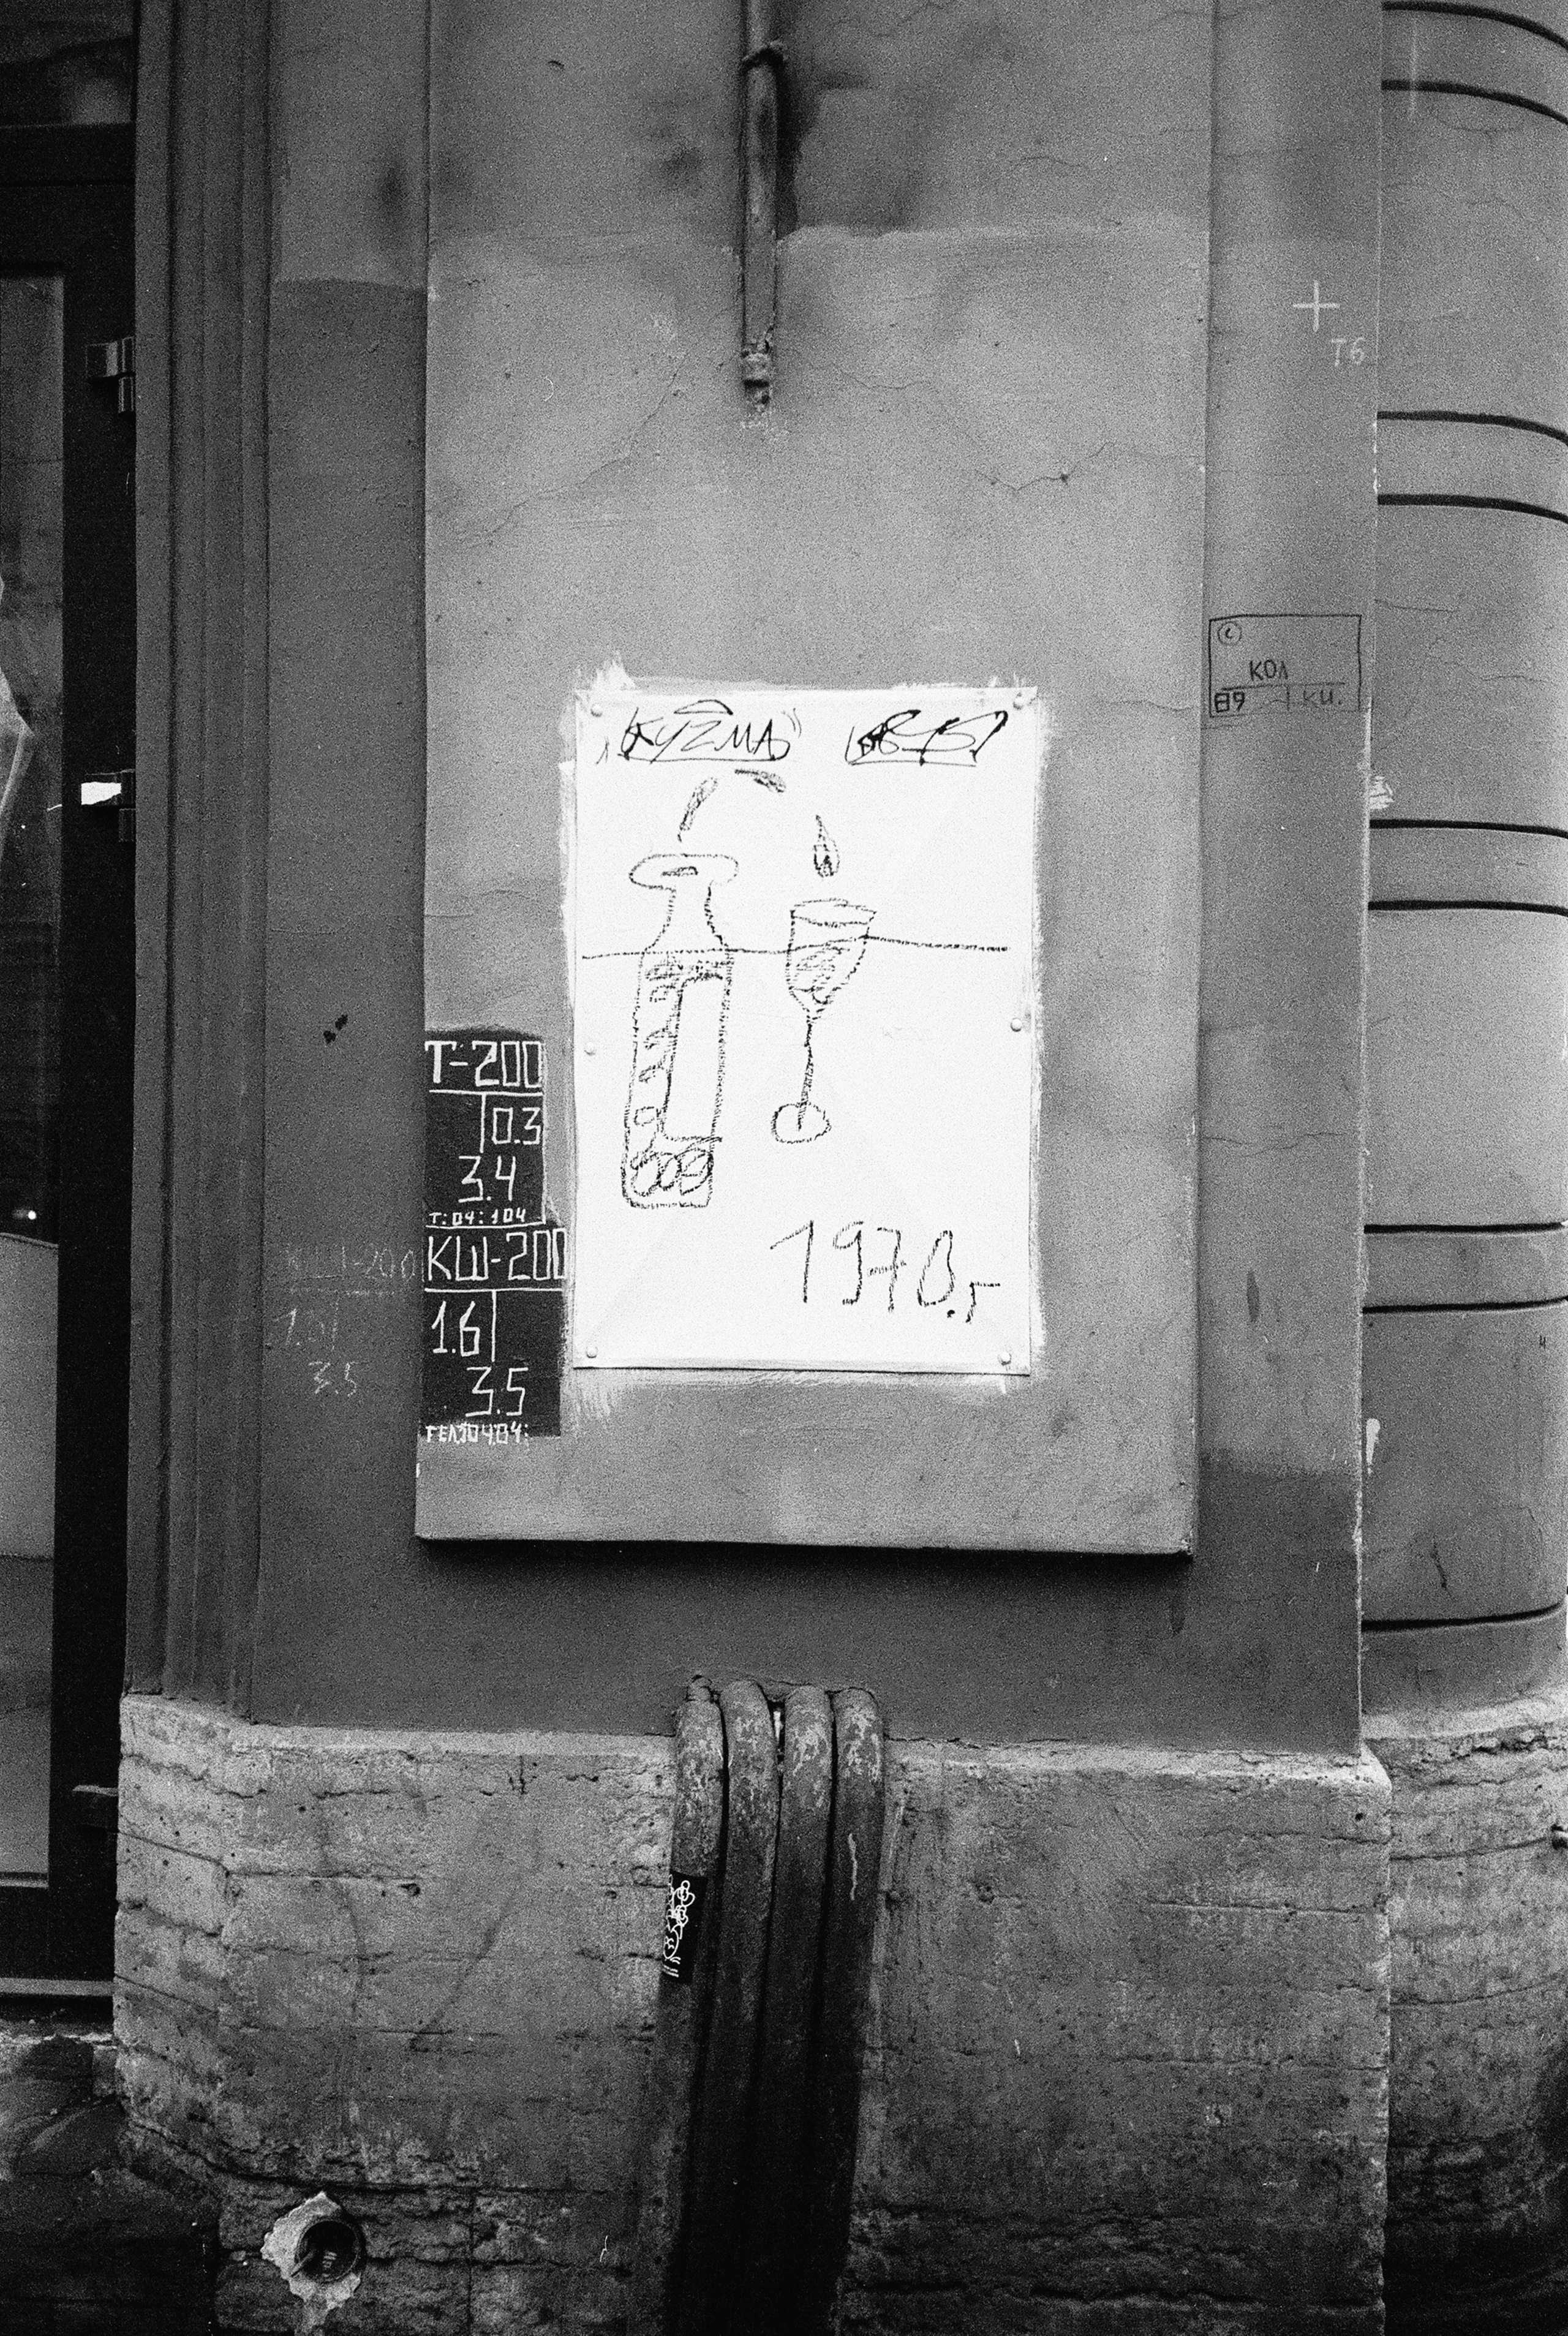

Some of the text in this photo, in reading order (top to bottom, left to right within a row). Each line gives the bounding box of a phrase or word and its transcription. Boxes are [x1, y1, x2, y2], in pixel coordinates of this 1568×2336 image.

[458, 1156, 516, 1203] 3.4
[431, 1300, 481, 1357] 1.6
[465, 1366, 529, 1417] 3.5
